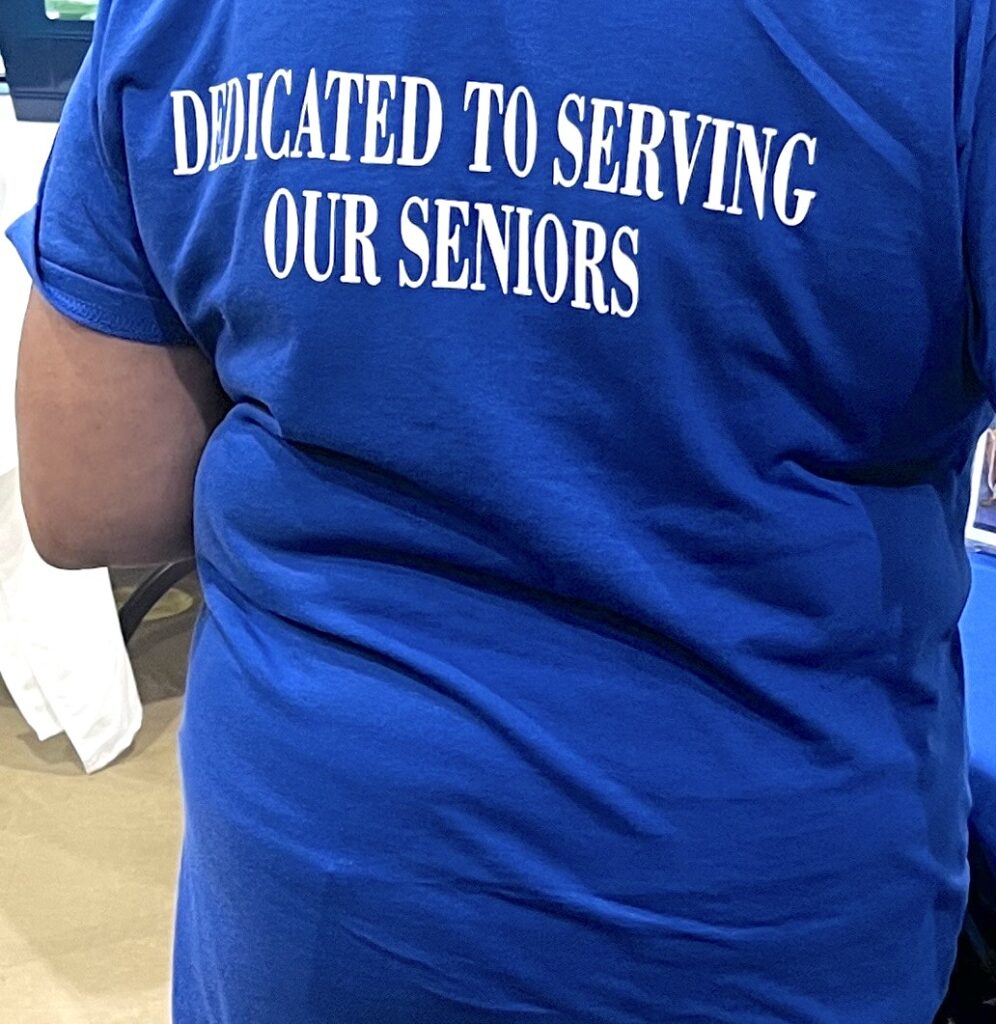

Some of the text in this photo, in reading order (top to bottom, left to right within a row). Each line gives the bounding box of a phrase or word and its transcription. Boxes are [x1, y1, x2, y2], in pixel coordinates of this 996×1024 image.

[170, 68, 818, 226] DEDICATED TO SERVING
[264, 188, 641, 318] OUR SENIORS
